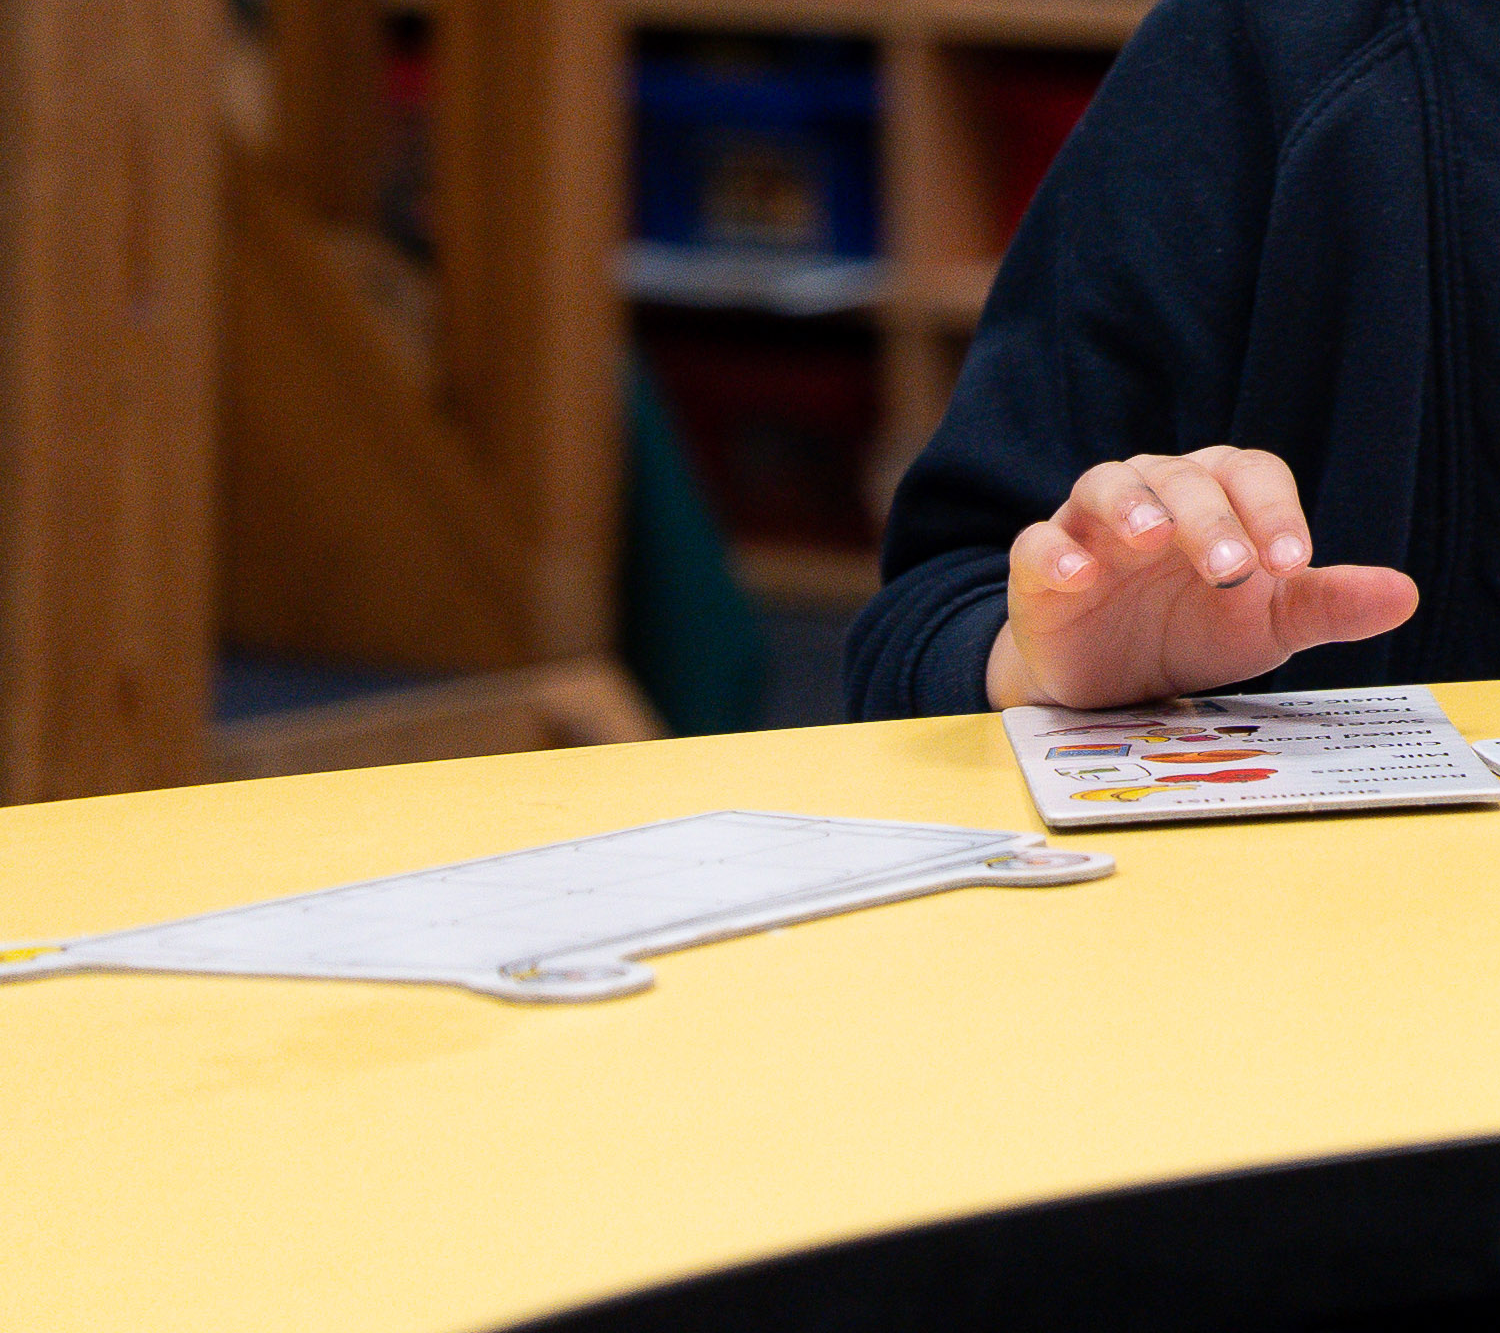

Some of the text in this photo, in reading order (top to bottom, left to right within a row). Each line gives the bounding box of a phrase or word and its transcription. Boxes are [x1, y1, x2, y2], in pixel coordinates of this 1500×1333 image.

[1278, 696, 1408, 708] Music CD
[1249, 708, 1417, 719] Toothpaste
[1242, 730, 1433, 744] Baked beans
[1392, 751, 1449, 760] Milk
[1310, 763, 1454, 774] Tomatoes
